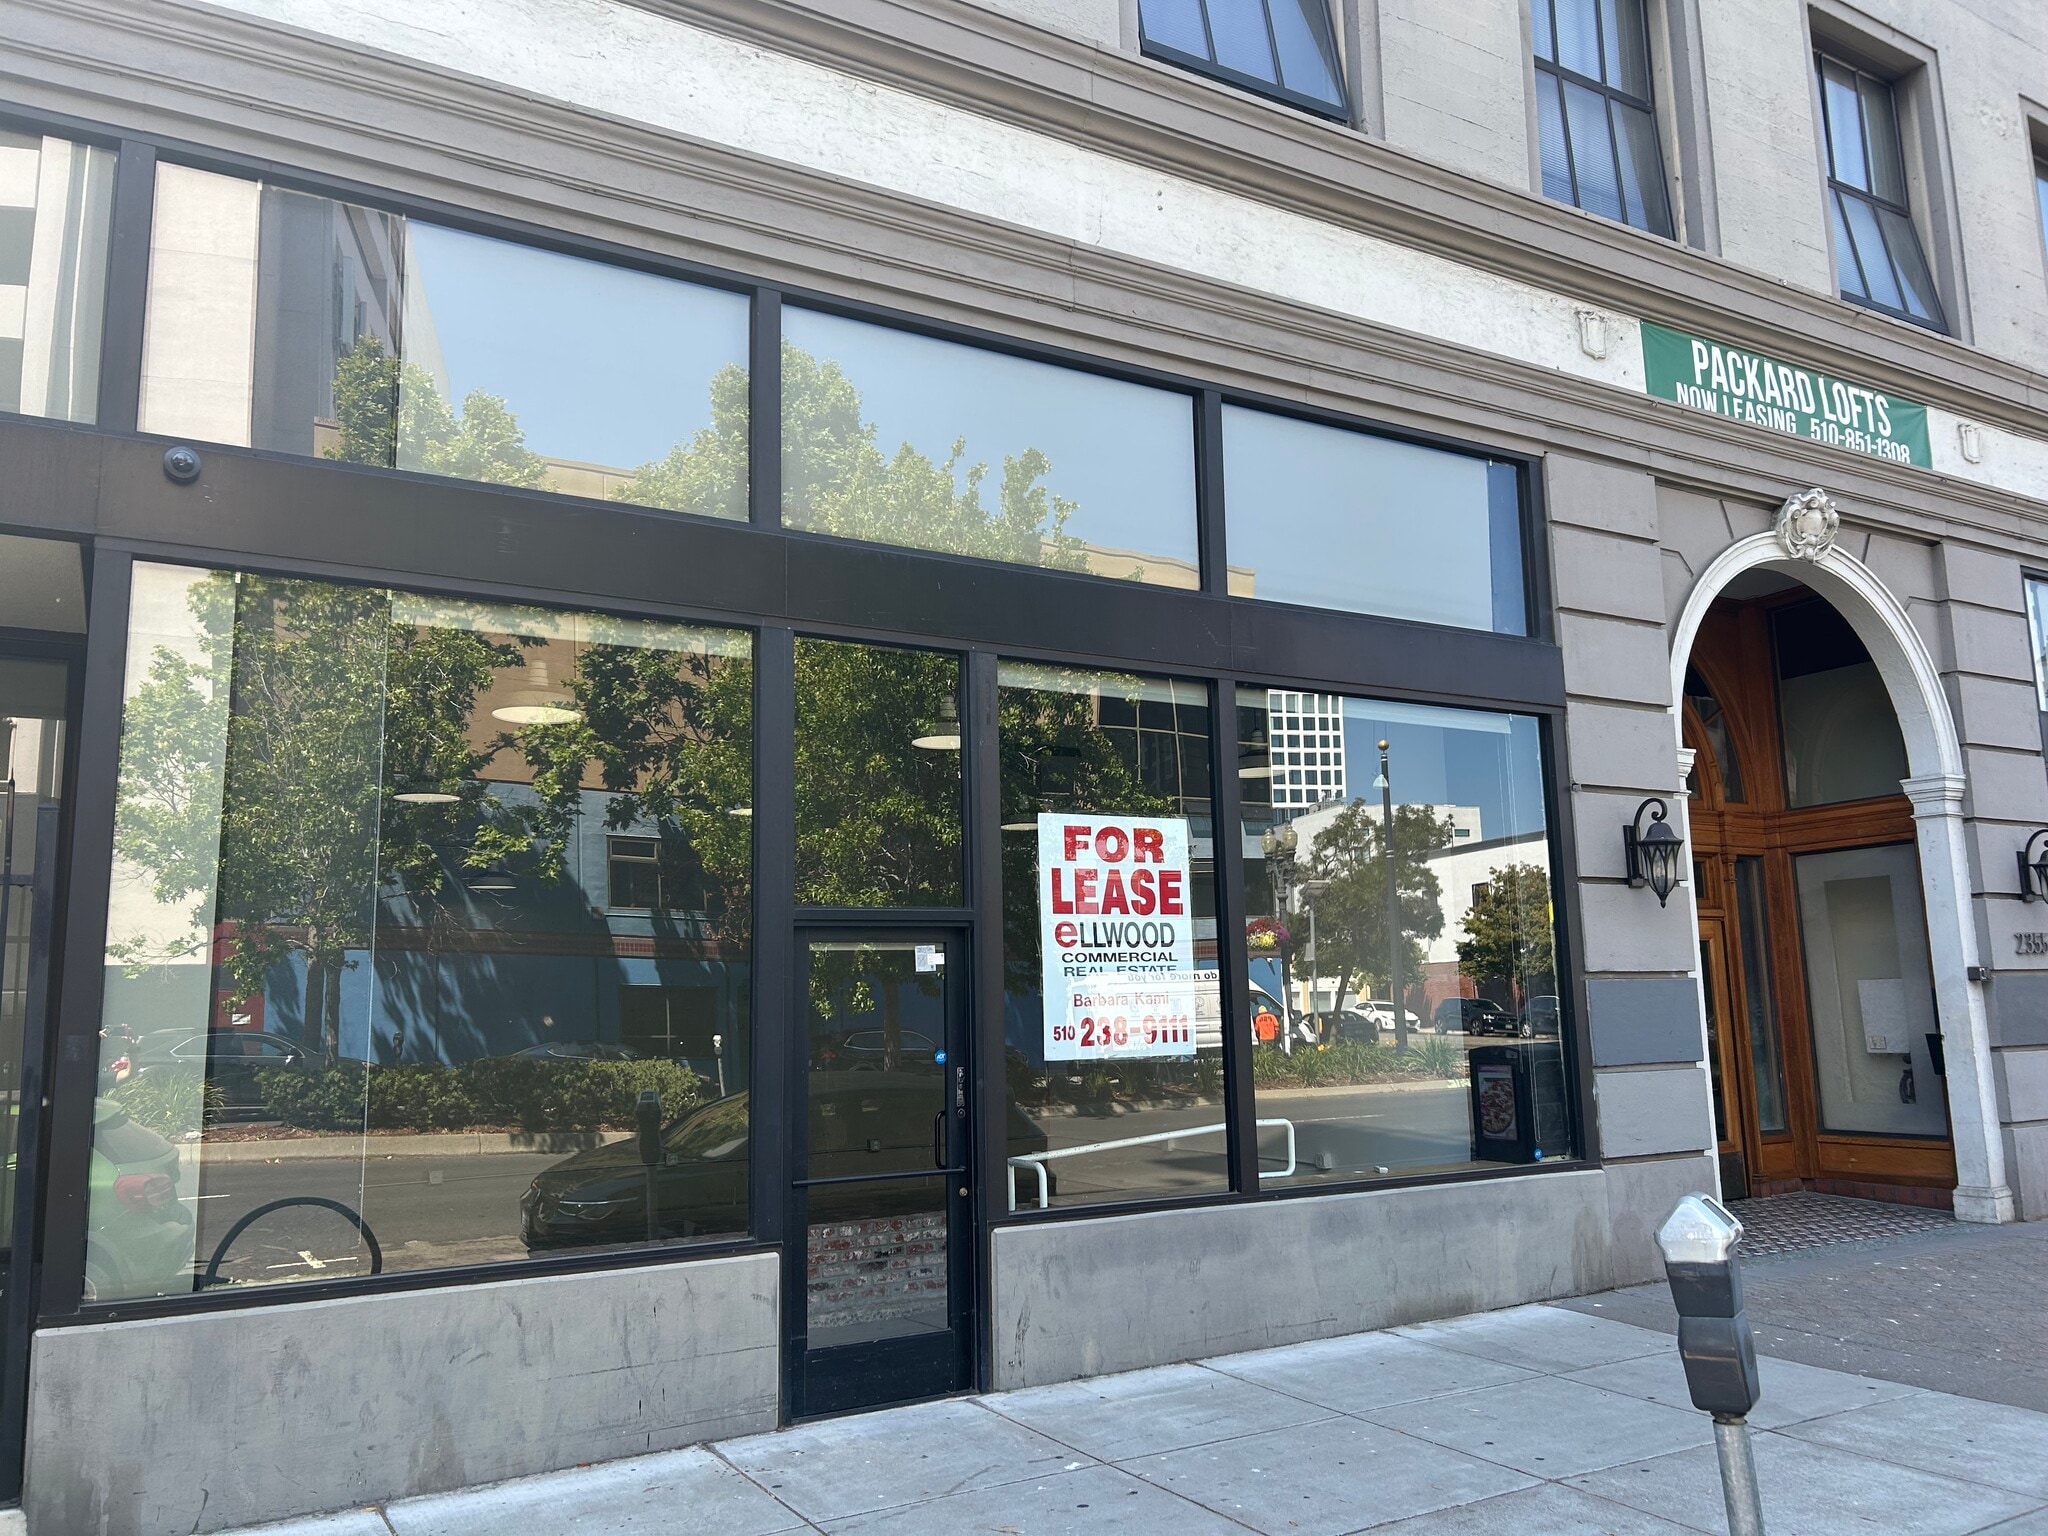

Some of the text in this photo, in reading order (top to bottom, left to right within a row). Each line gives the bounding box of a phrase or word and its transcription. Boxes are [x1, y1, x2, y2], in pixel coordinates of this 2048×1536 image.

[1691, 339, 1892, 438] PACKARD LOFTS
[1676, 382, 1717, 413] NOW
[1722, 395, 1797, 434] LEASING
[1063, 825, 1165, 863] FOR
[1051, 868, 1184, 916] LEASE
[1061, 952, 1178, 963] COMMERCIAL
[1064, 966, 1109, 977] REAL
[1073, 993, 1129, 1008] Barbara
[1053, 1025, 1076, 1041] 510
